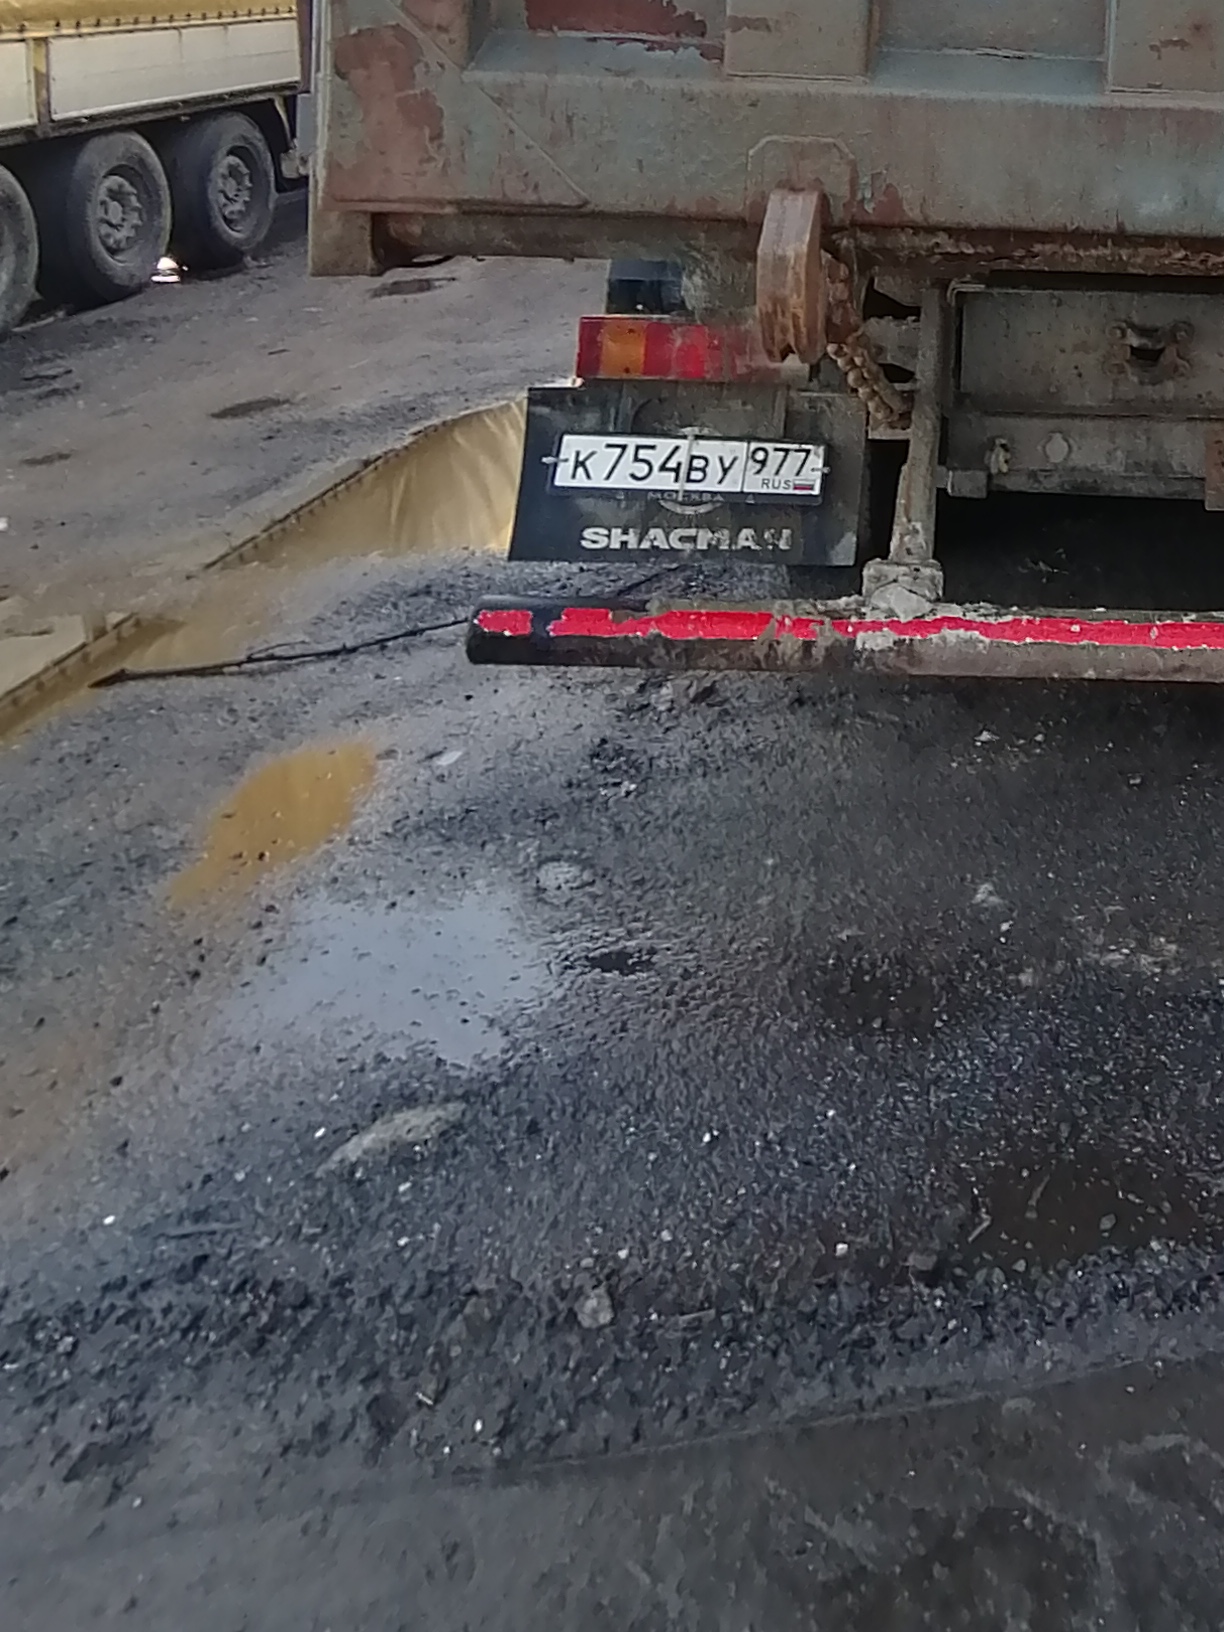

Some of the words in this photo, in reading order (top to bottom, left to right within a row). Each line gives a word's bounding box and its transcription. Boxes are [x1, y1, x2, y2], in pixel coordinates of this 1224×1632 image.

[750, 447, 811, 477] 977
[761, 478, 793, 490] RUS
[580, 526, 793, 550] SHACMAN
